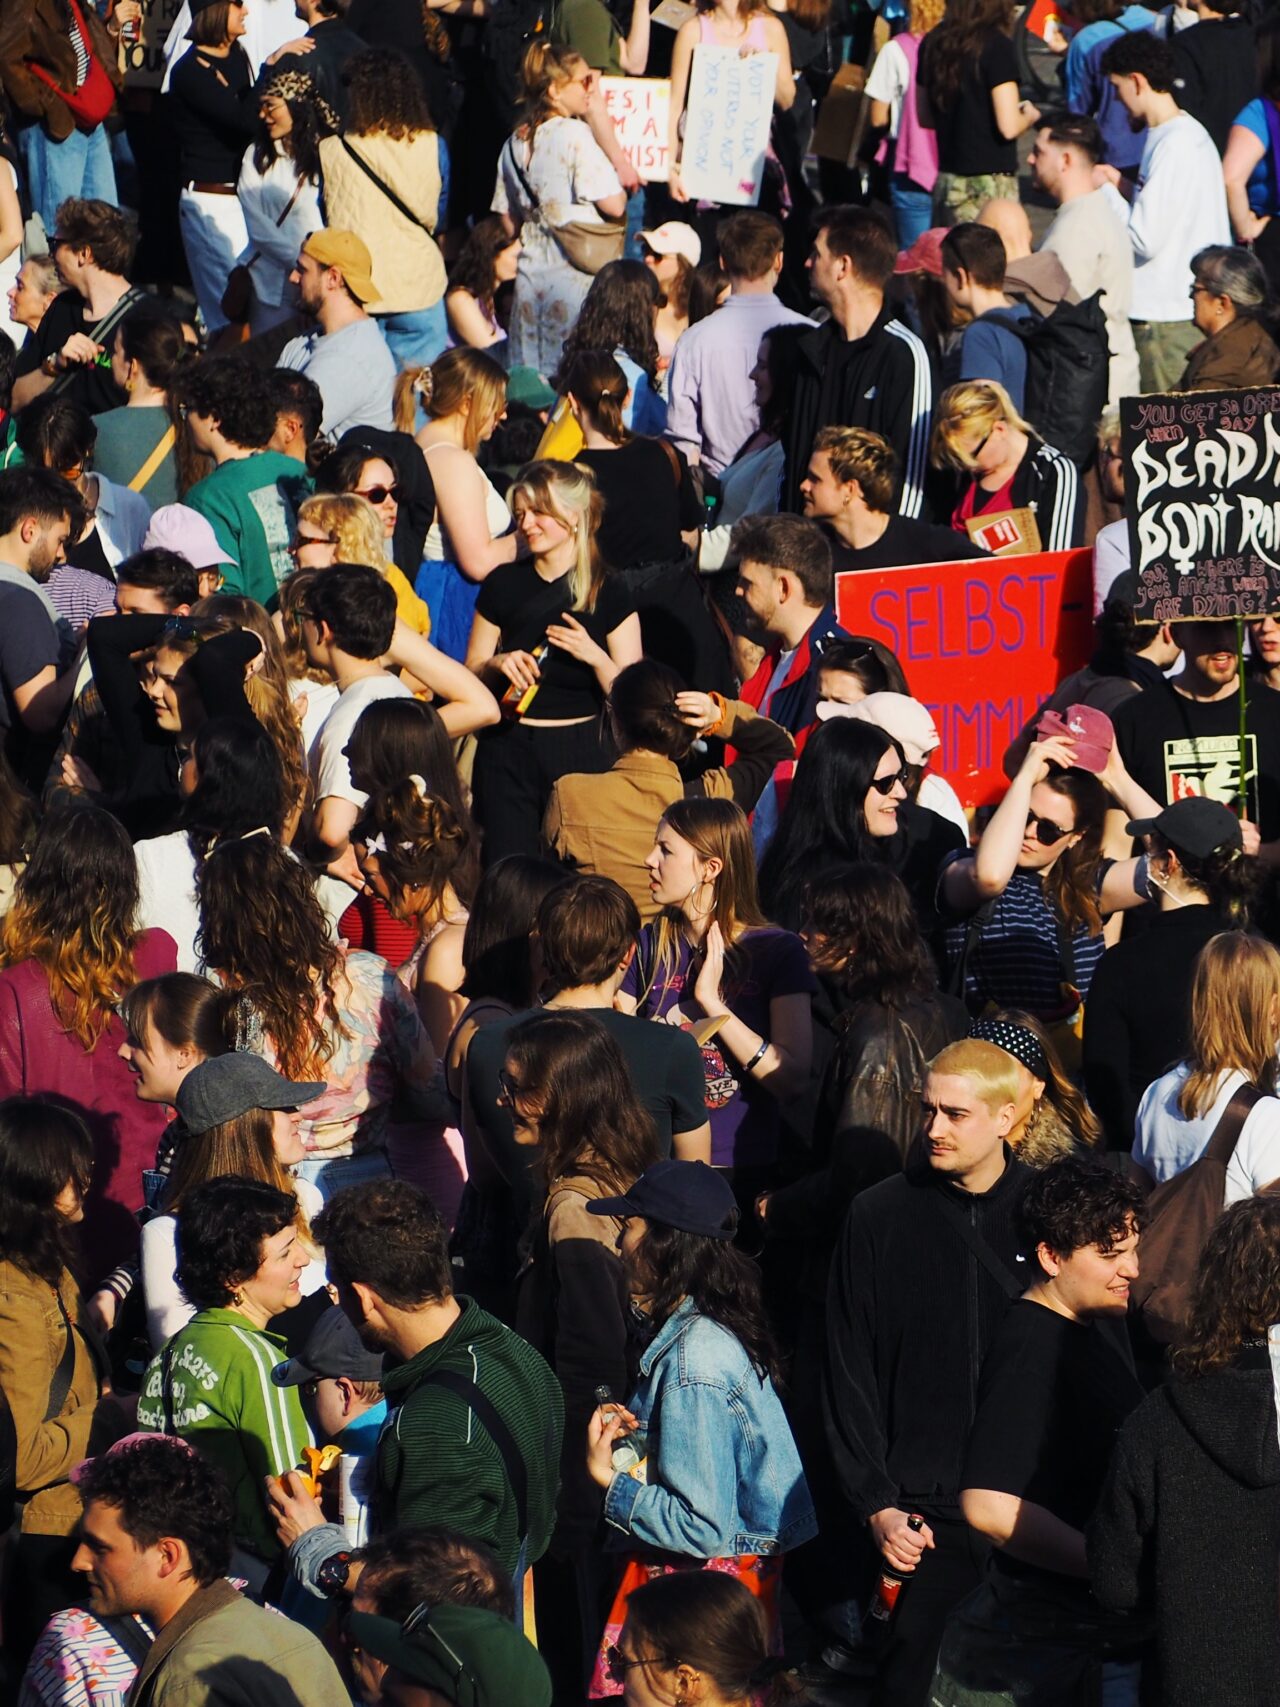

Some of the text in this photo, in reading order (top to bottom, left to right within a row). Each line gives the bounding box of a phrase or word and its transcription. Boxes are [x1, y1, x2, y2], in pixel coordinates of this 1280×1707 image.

[605, 89, 637, 114] ES,
[642, 117, 658, 138] A
[622, 144, 669, 167] NIST
[1130, 404, 1177, 432] YOU
[1180, 403, 1219, 424] GET
[1219, 398, 1241, 417] SO
[1197, 422, 1208, 440] I
[1220, 416, 1257, 433] SAY
[1131, 428, 1258, 513] DEAD
[1153, 596, 1185, 621] ARE
